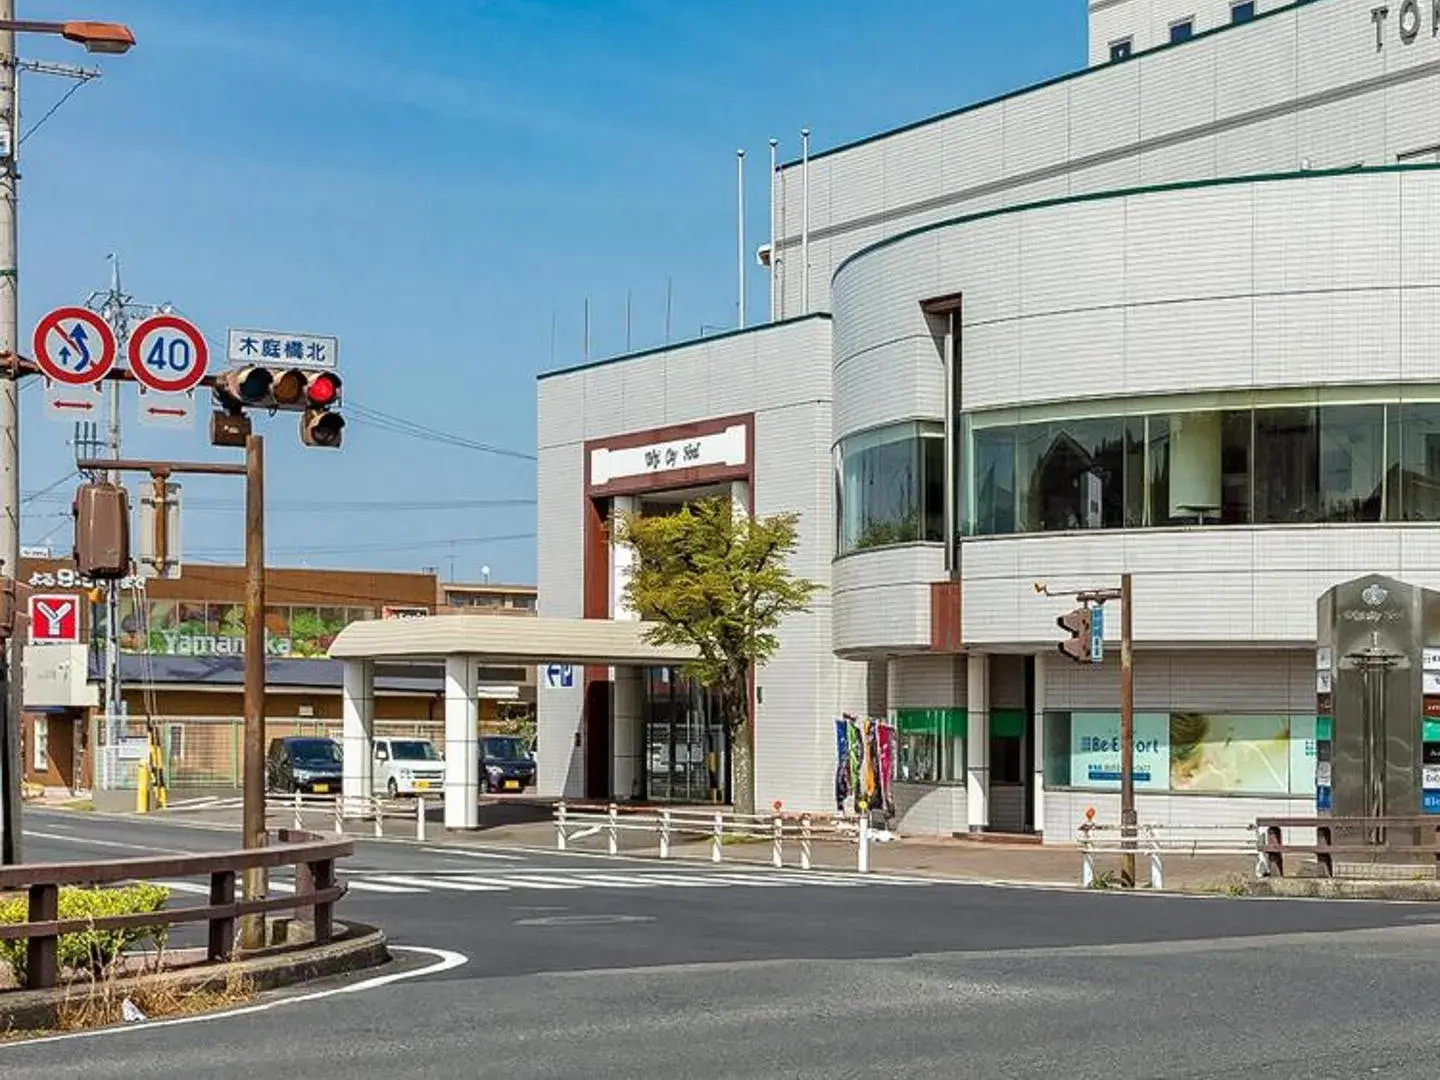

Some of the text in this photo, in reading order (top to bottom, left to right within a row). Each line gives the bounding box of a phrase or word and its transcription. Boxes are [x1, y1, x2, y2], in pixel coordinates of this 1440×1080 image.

[147, 336, 190, 371] 40
[239, 335, 326, 362] 木庭橋北
[164, 630, 292, 655] Yamanka
